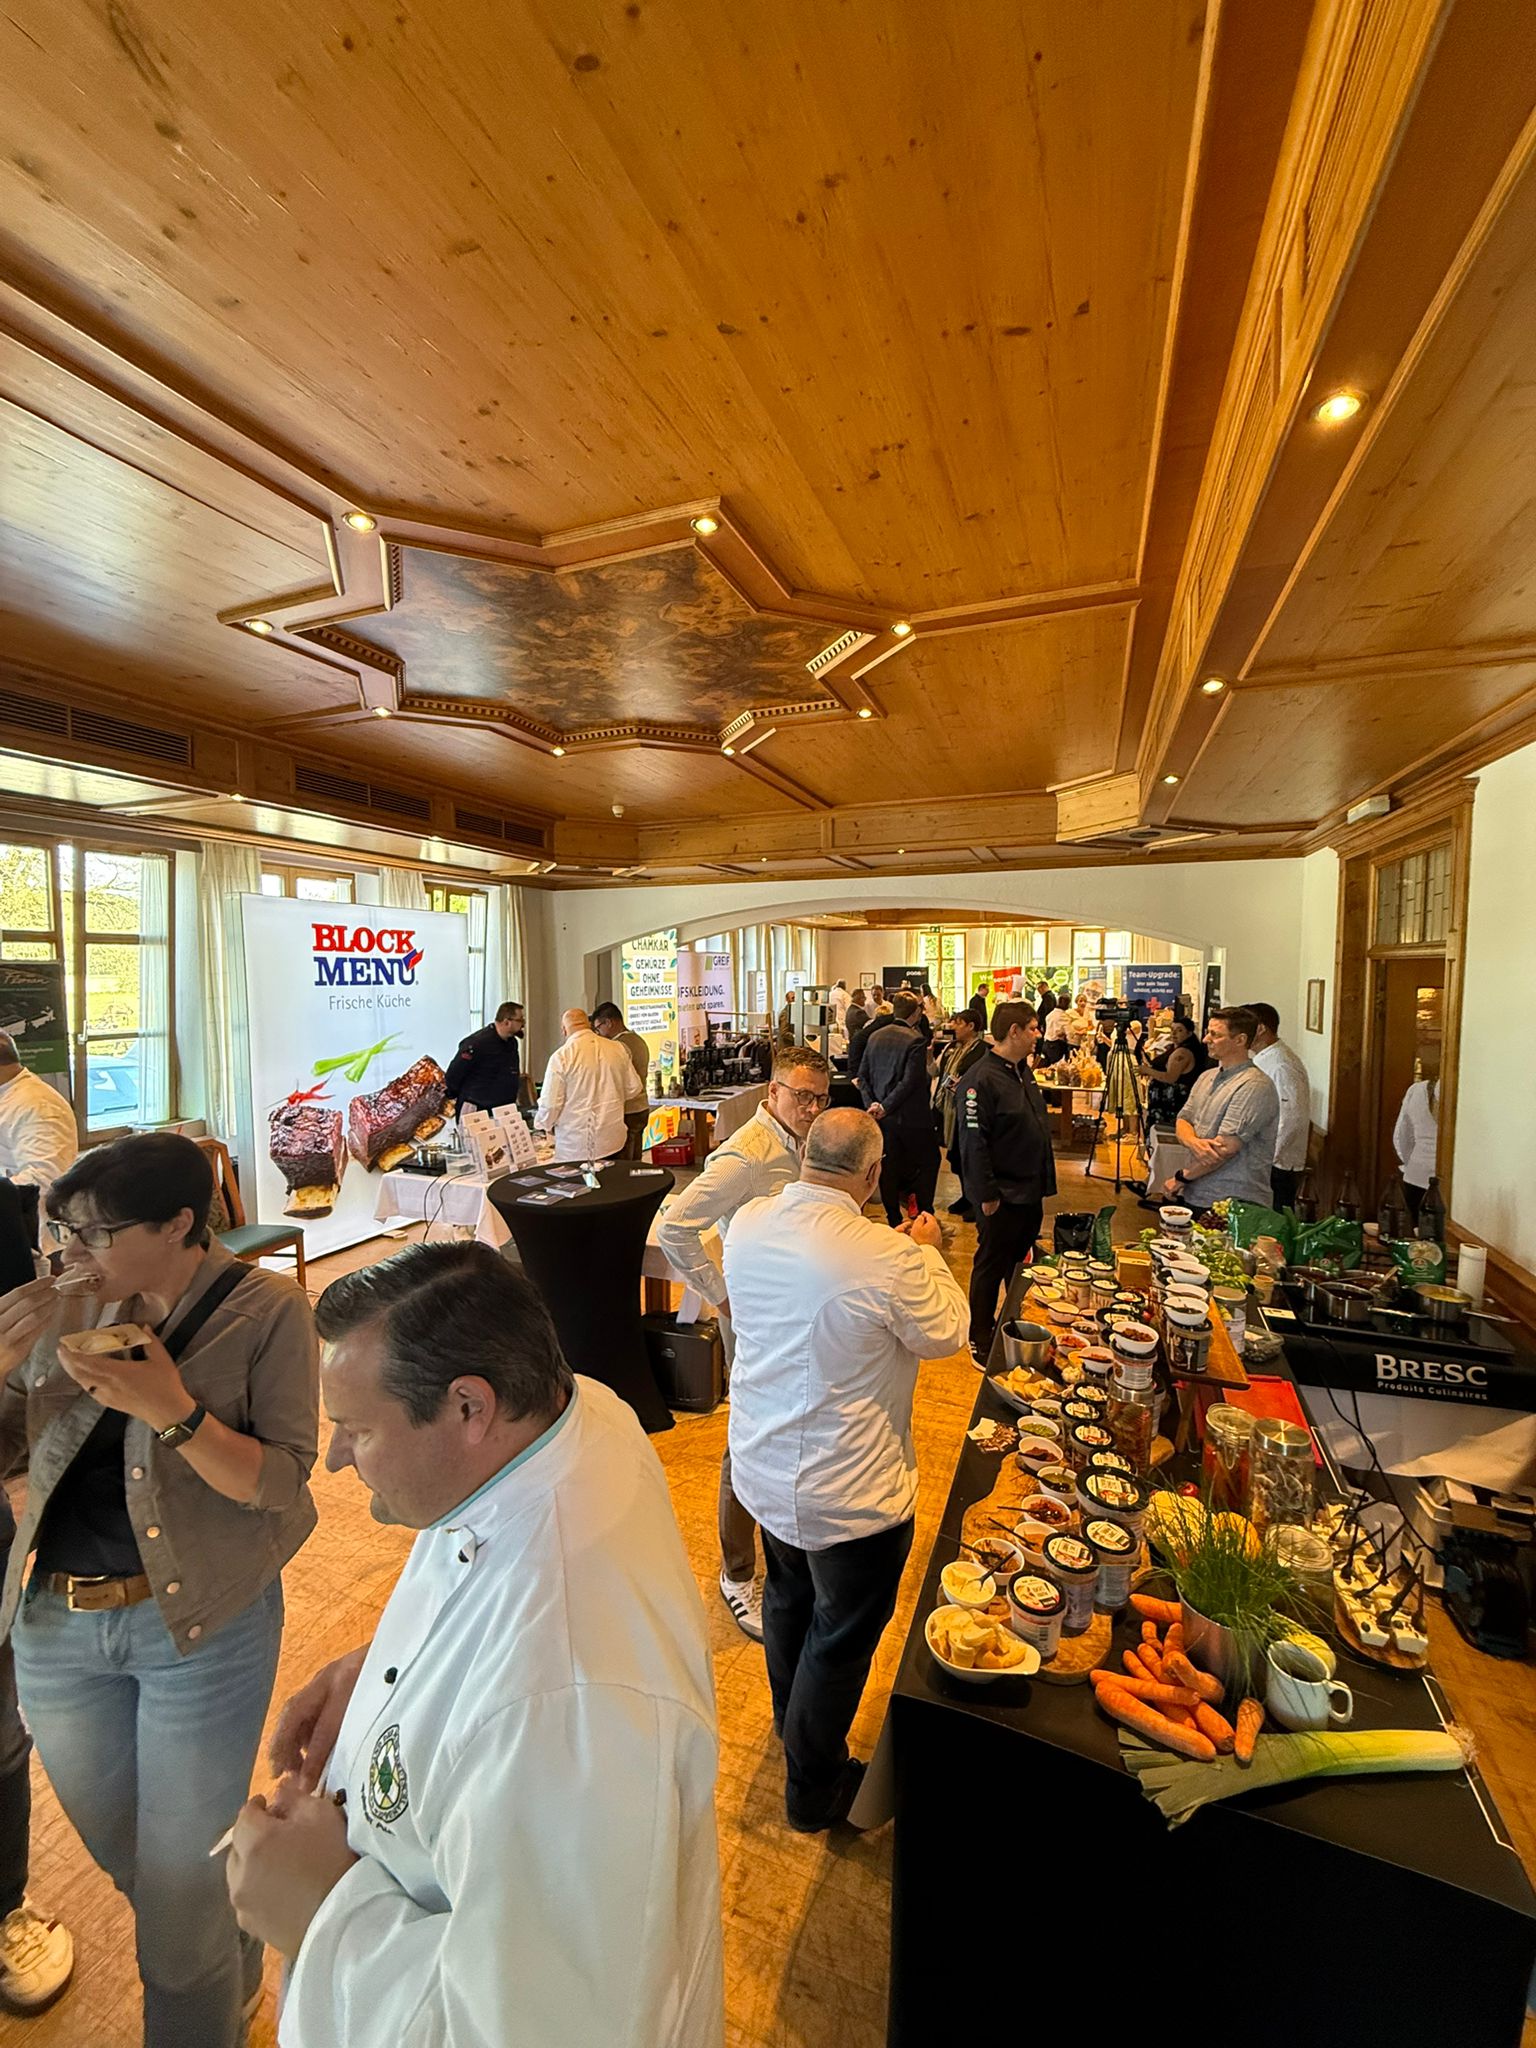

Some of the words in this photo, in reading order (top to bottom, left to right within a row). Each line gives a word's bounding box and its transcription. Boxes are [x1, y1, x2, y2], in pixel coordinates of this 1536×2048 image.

[311, 923, 416, 953] BLOCK
[635, 957, 666, 969] GEWÜRZE
[713, 955, 730, 966] GREIF
[313, 956, 415, 986] MENU
[642, 973, 660, 983] OHNE
[630, 985, 673, 997] GEHEIMNISSE
[328, 995, 373, 1010] Frische
[376, 994, 412, 1008] Küche
[696, 1001, 706, 1010] und
[1374, 1354, 1488, 1386] BRESC
[1377, 1381, 1425, 1393] Produits
[1428, 1387, 1488, 1400] Culinaires
